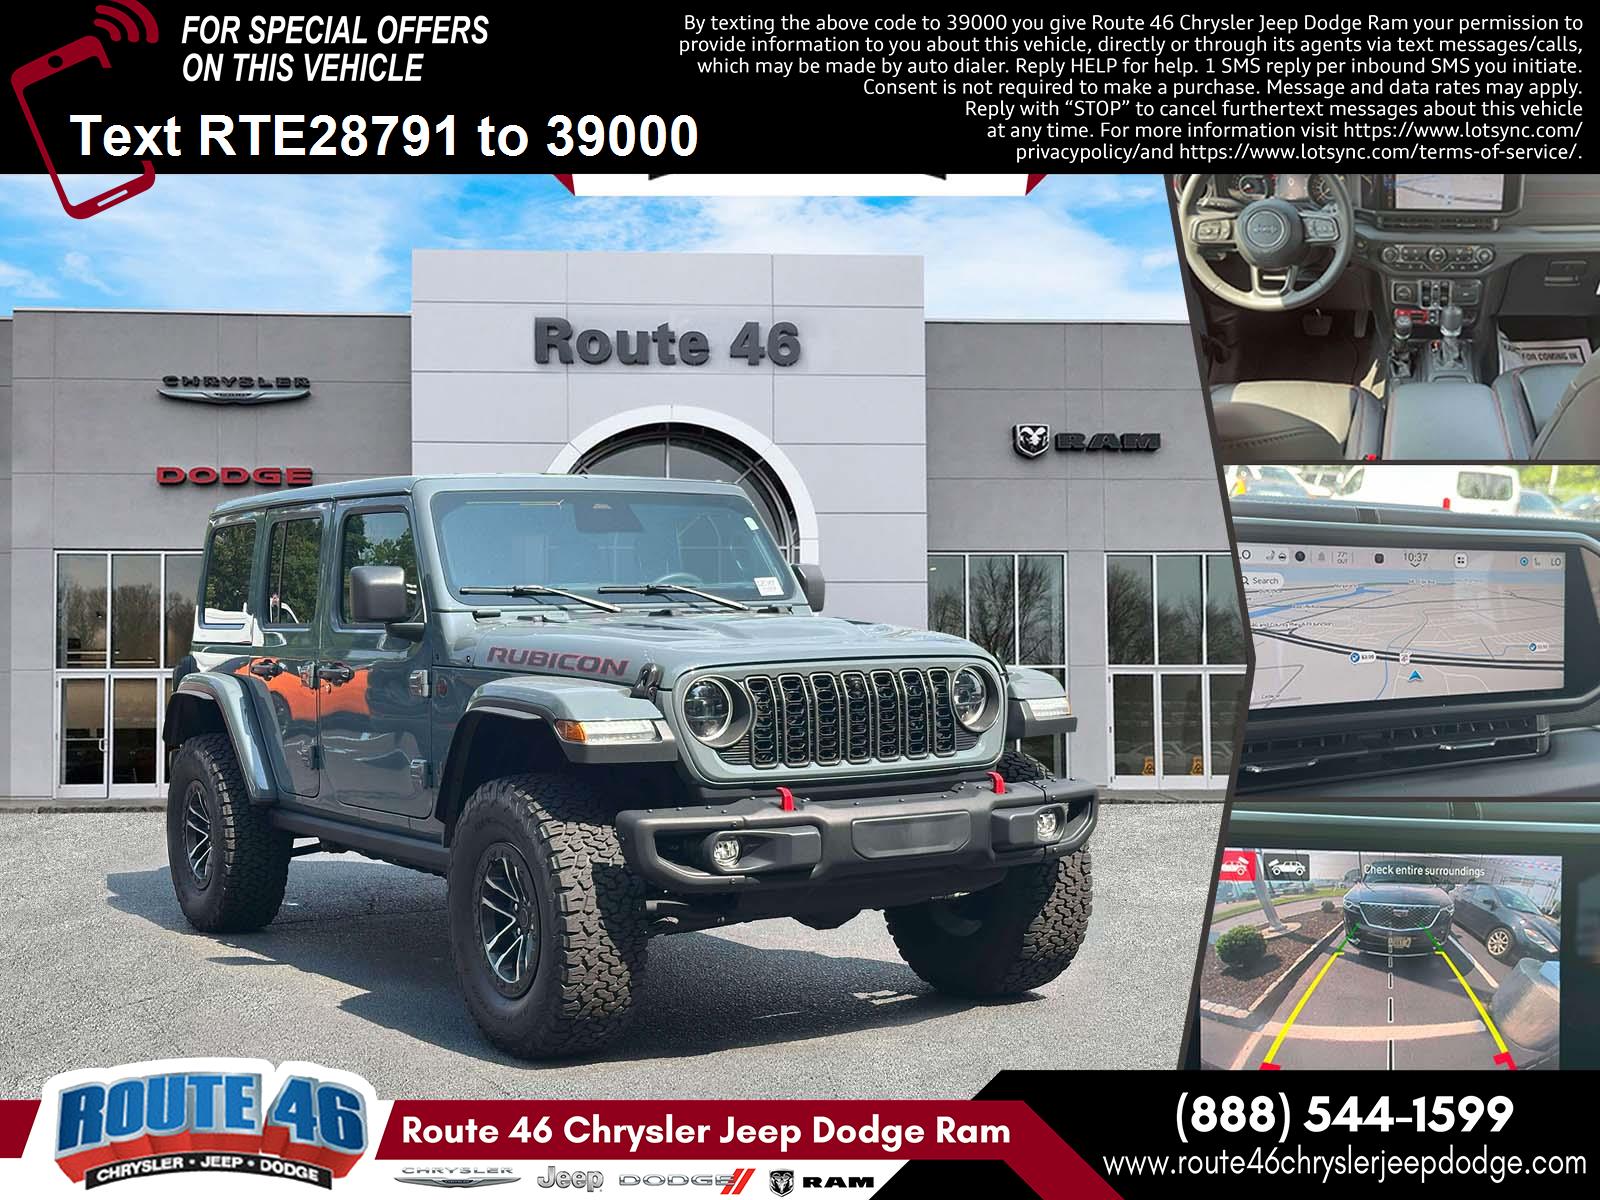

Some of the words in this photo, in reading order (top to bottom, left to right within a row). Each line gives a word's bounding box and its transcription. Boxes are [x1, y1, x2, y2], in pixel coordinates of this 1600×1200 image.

[535, 318, 710, 366] Route
[730, 321, 800, 367] 46
[1538, 352, 1568, 361] COMING
[163, 375, 311, 389] CHRYSLER
[1055, 432, 1161, 452] RAM
[156, 466, 313, 486] DODGE
[1403, 552, 1428, 562] 10:37
[1551, 557, 1562, 566] LO
[1253, 576, 1280, 585] Search
[486, 646, 630, 677] RUBICON
[1363, 864, 1394, 875] Check
[1396, 865, 1423, 875] entire
[1425, 866, 1485, 878] surroundings
